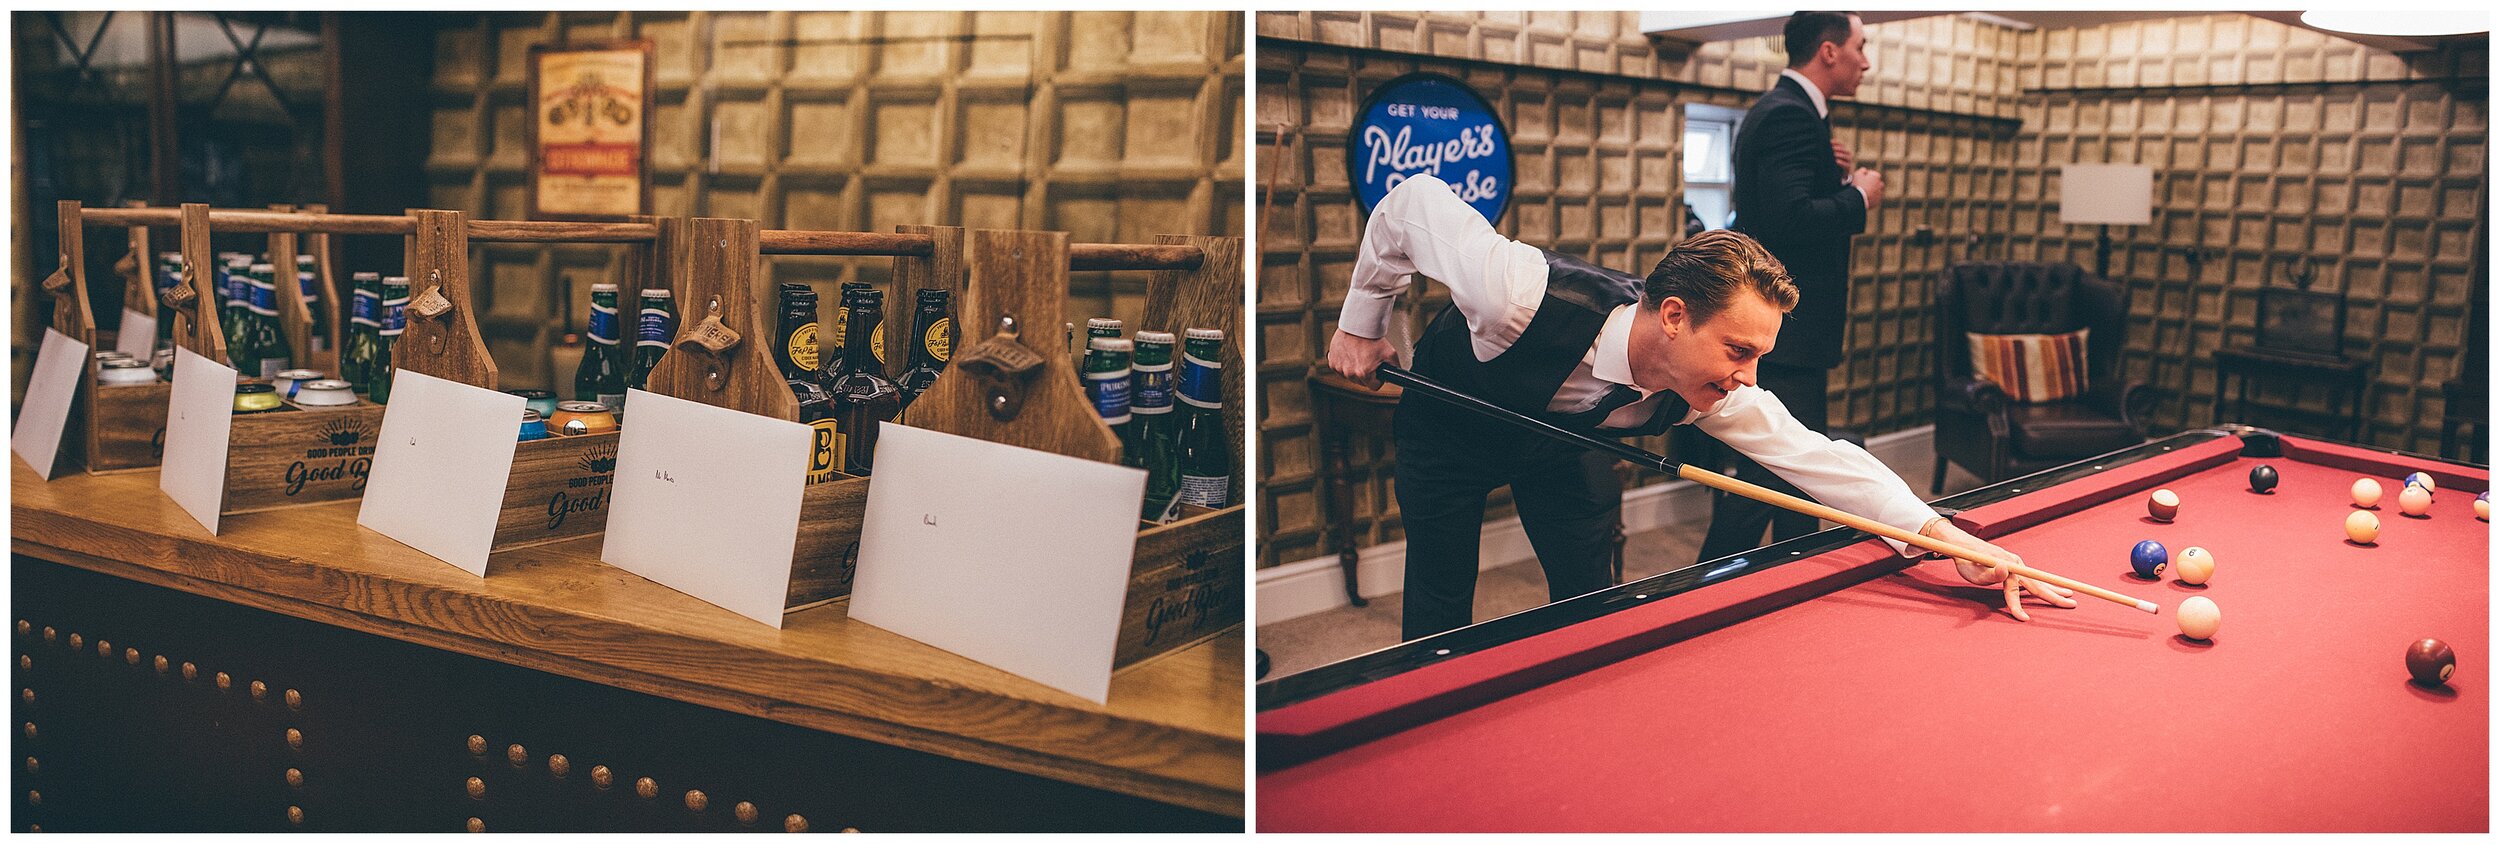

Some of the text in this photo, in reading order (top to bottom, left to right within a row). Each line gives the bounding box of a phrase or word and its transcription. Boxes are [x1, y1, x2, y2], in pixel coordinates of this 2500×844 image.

[1387, 103, 1460, 121] GET YOUR
[1364, 123, 1496, 185] Player's
[307, 448, 328, 459] GOOD
[329, 446, 357, 458] PEOPLE
[285, 459, 346, 497] Good
[568, 477, 588, 489] GOOD
[548, 490, 604, 531] Good
